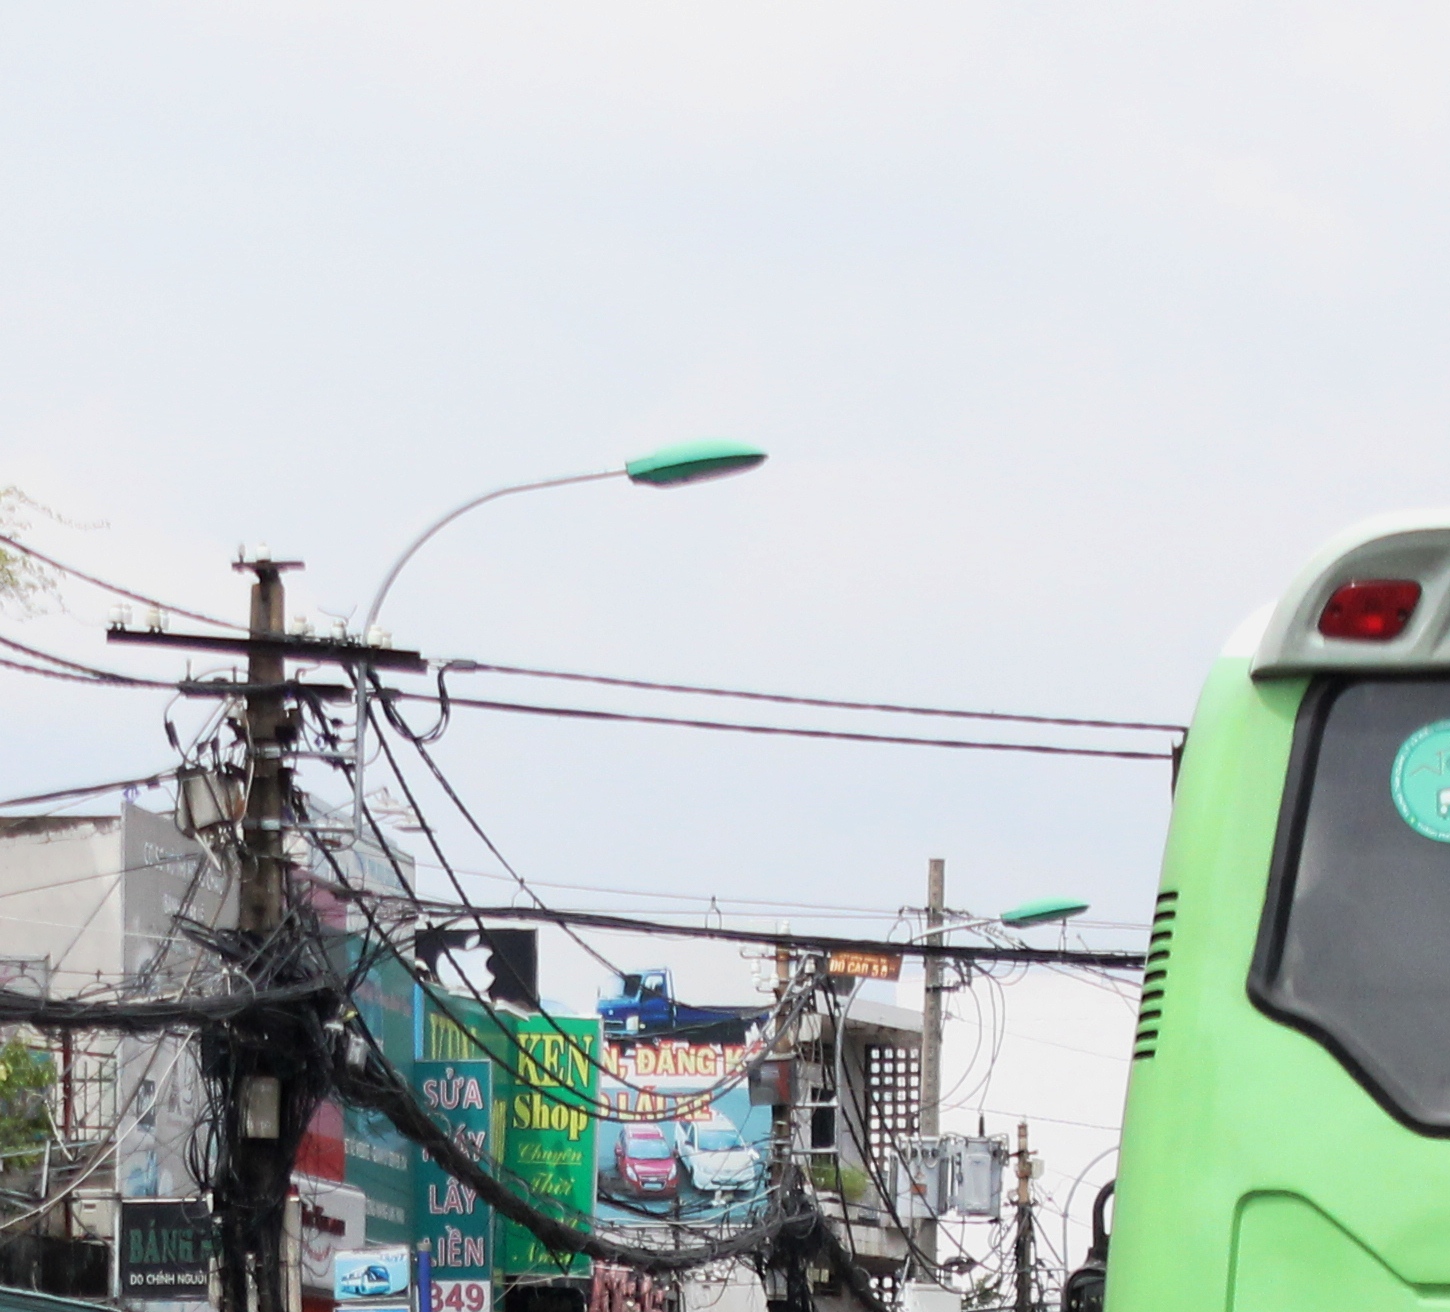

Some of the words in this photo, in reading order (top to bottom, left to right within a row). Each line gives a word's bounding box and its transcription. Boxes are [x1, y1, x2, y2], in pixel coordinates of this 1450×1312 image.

[515, 1033, 594, 1089] KEN
[635, 1040, 717, 1076] ĐĂNG
[423, 1067, 484, 1110] SỬA
[512, 1092, 589, 1141] Shop
